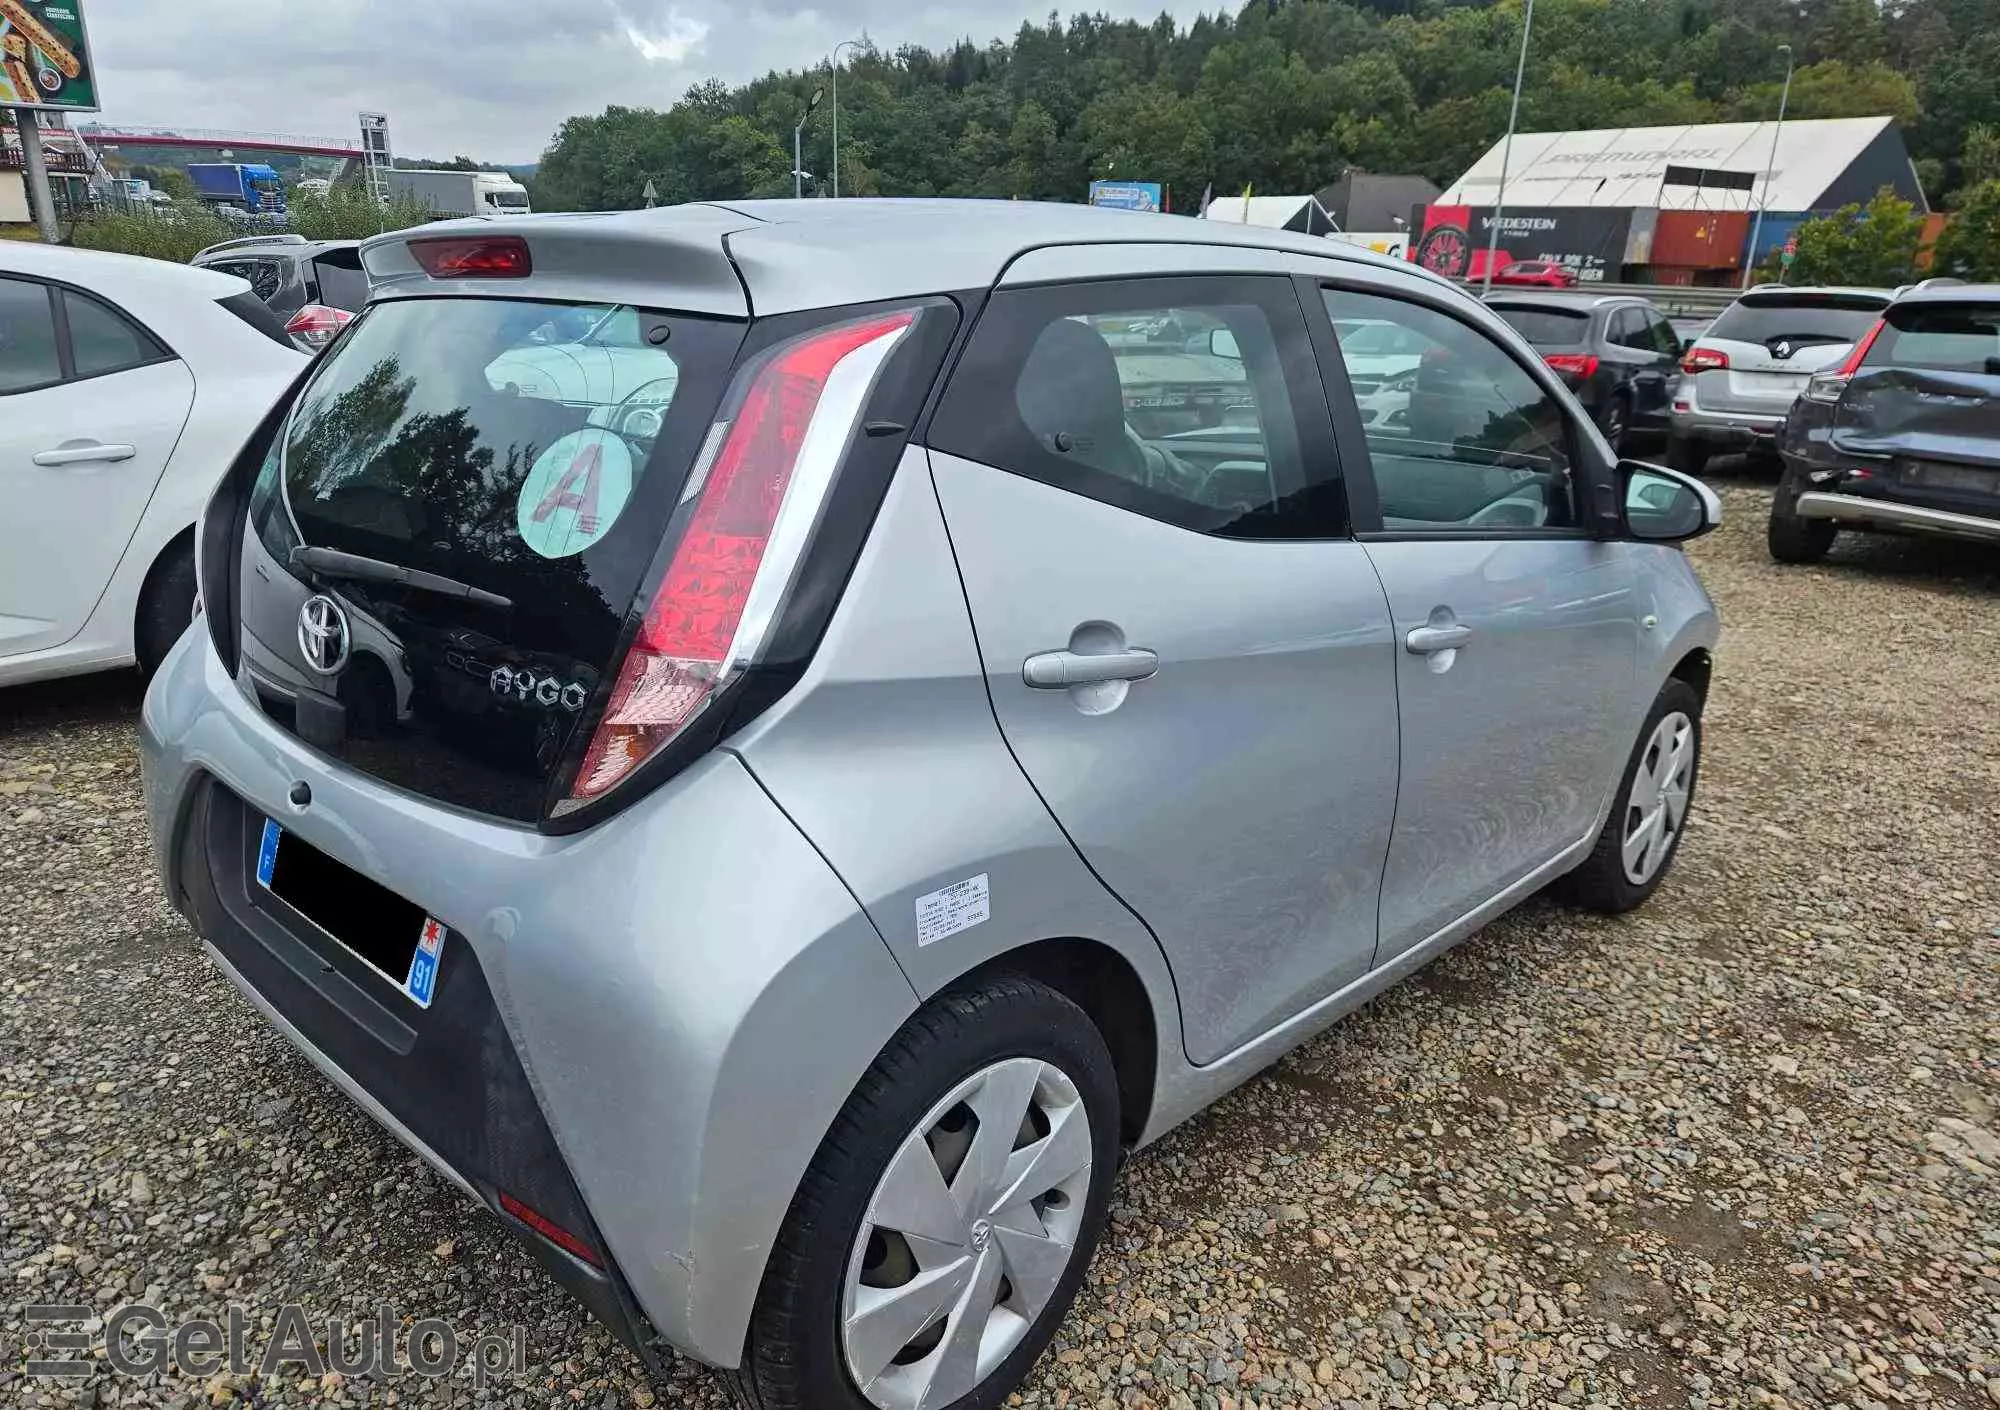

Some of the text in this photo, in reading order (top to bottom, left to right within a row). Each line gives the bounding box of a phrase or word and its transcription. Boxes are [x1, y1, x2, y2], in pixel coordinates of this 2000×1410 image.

[529, 442, 605, 536] A
[490, 664, 587, 712] AYGO
[263, 854, 271, 869] F
[413, 959, 433, 994] 91
